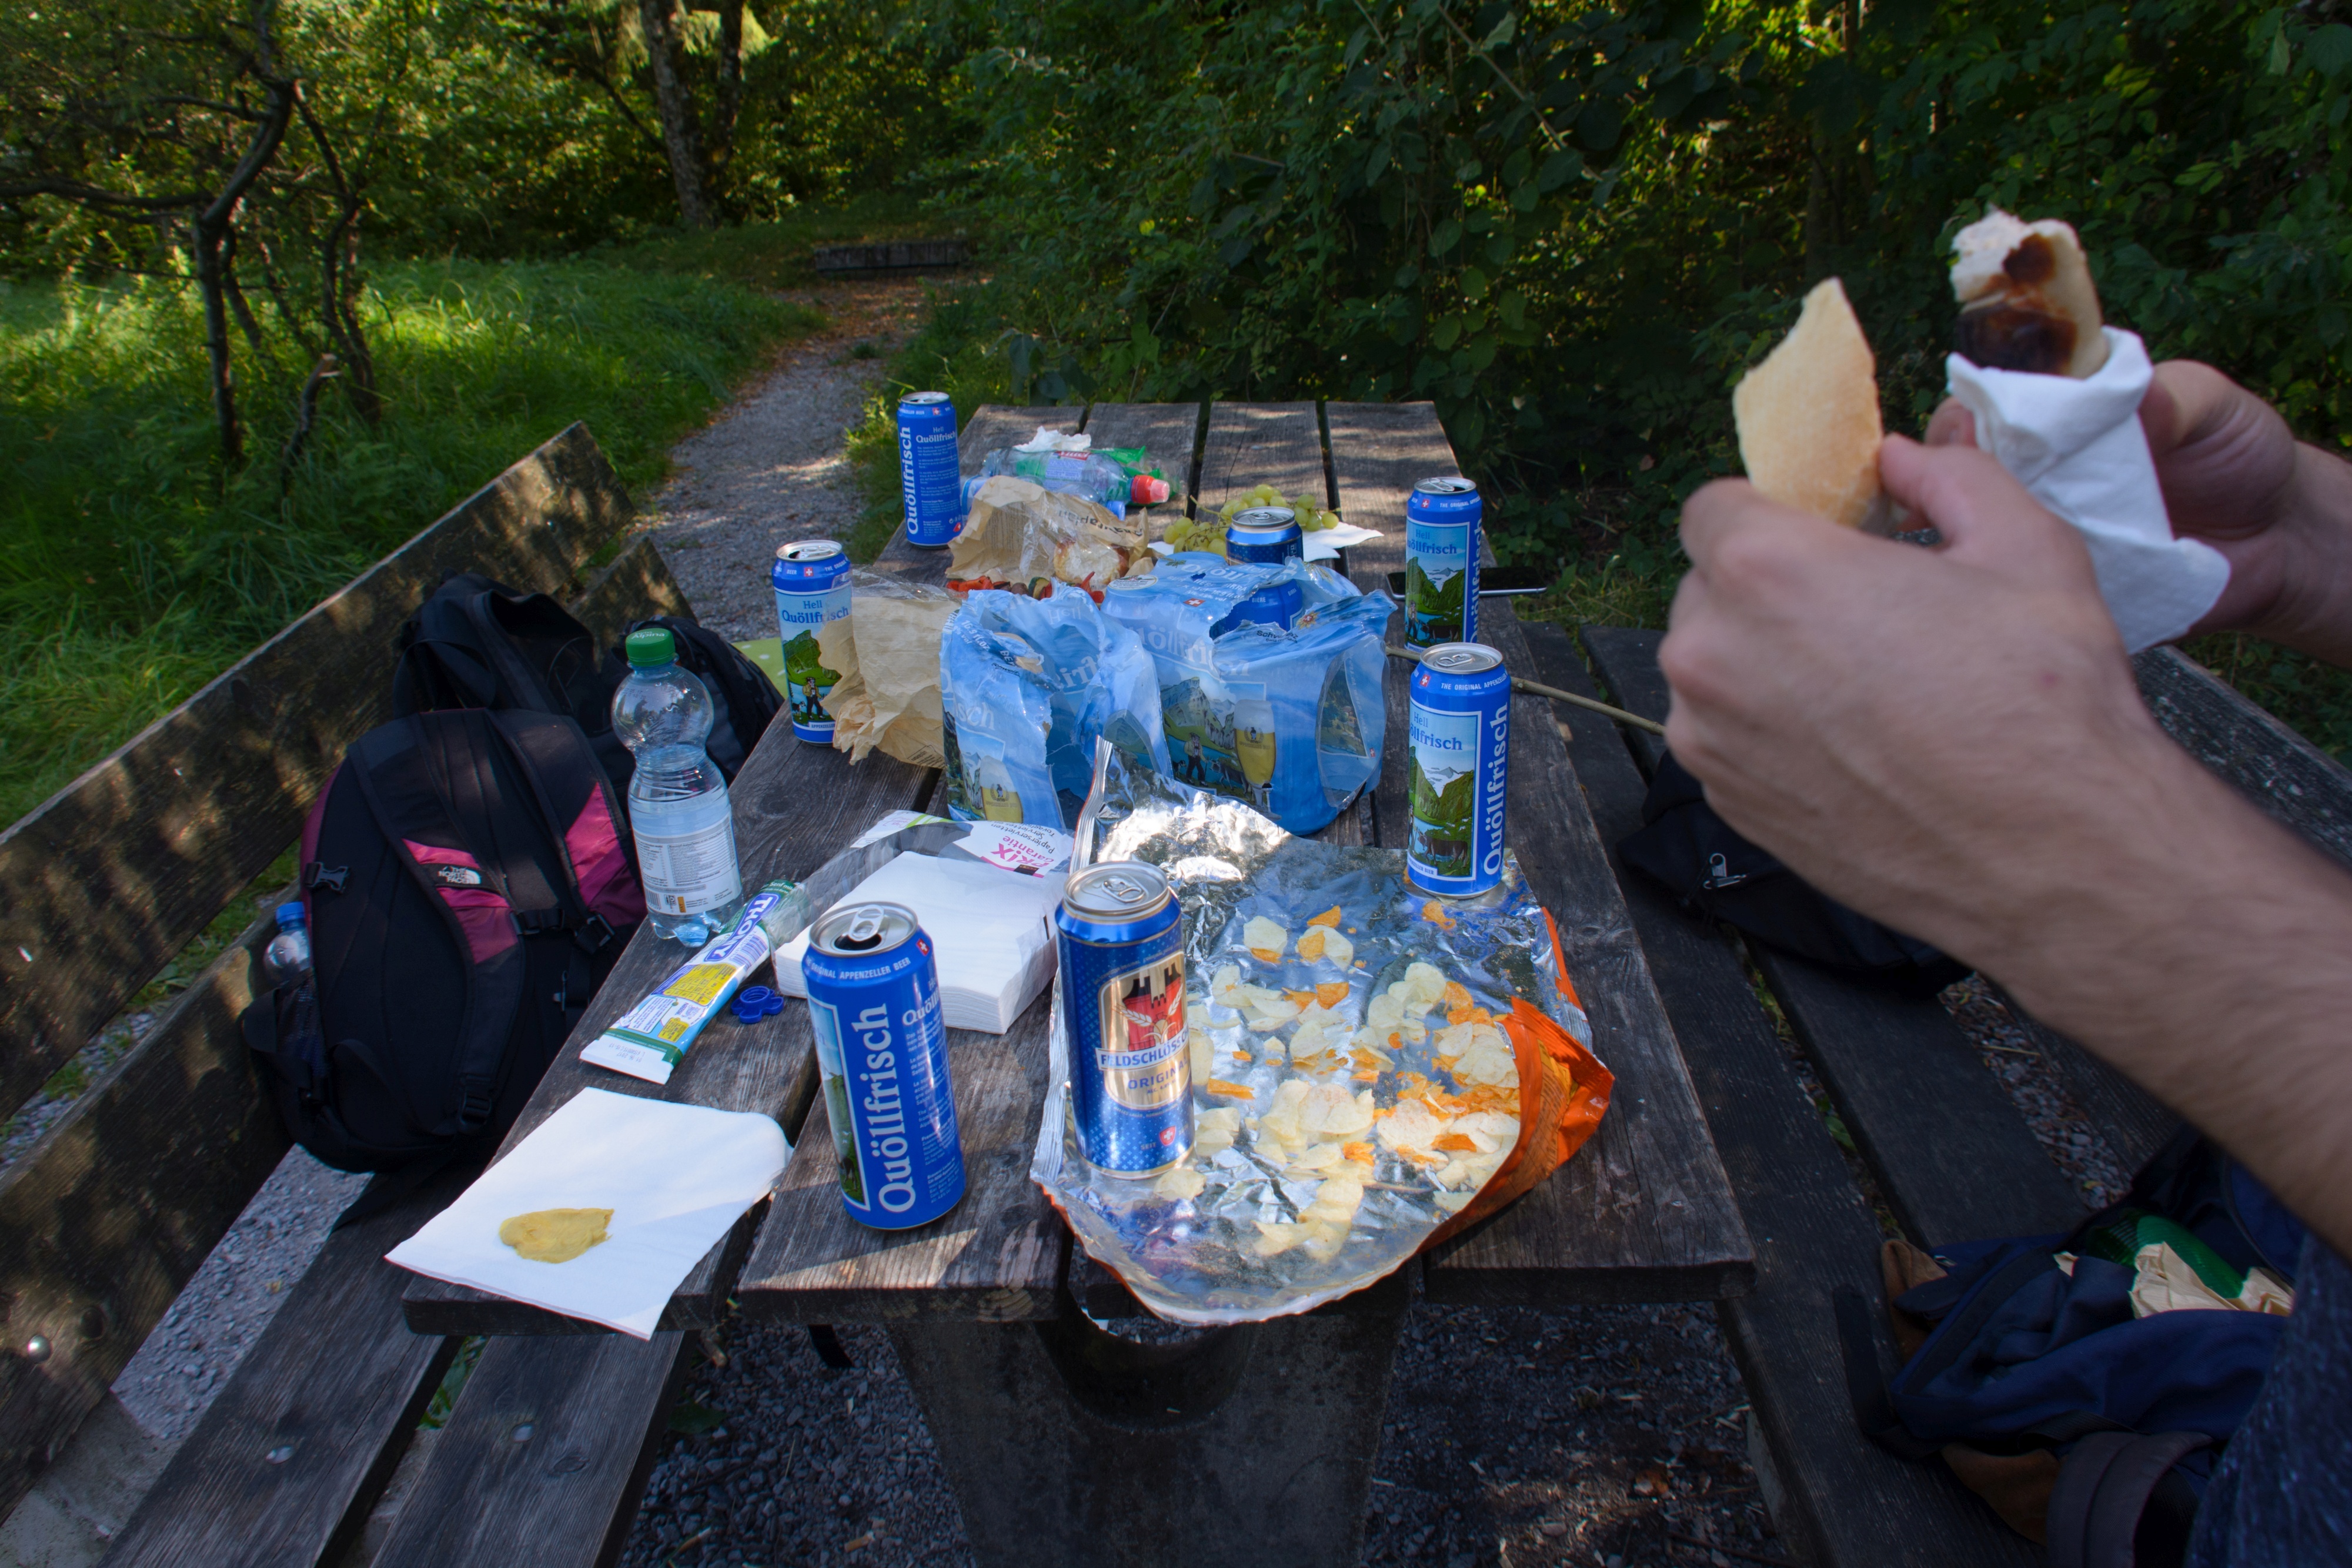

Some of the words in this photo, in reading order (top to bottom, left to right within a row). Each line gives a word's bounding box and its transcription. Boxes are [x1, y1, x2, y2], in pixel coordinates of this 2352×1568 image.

[916, 431, 957, 443] Quöllfrisch
[900, 427, 919, 534] Quöllfrisch
[1415, 529, 1431, 540] Hell
[1407, 539, 1457, 554] uöllfrisch
[803, 600, 823, 609] Hell
[961, 634, 973, 644] vol
[1484, 673, 1507, 688] APPENZELLER
[1414, 712, 1429, 728] Hell
[1409, 722, 1463, 751] öllfrisch
[1483, 702, 1508, 875] Quöllfrisch
[991, 824, 1055, 854] Papierservietten
[1005, 823, 1045, 840] Serviettes
[1003, 835, 1054, 862] Garantie
[811, 962, 836, 979] ORIGINAL
[839, 965, 891, 980] APPENZELLER
[893, 957, 911, 971] BEER
[1128, 1056, 1188, 1089] ORIGINAL
[851, 1004, 916, 1213] Quöllfrisch
[1140, 1142, 1157, 1150] SEIT
